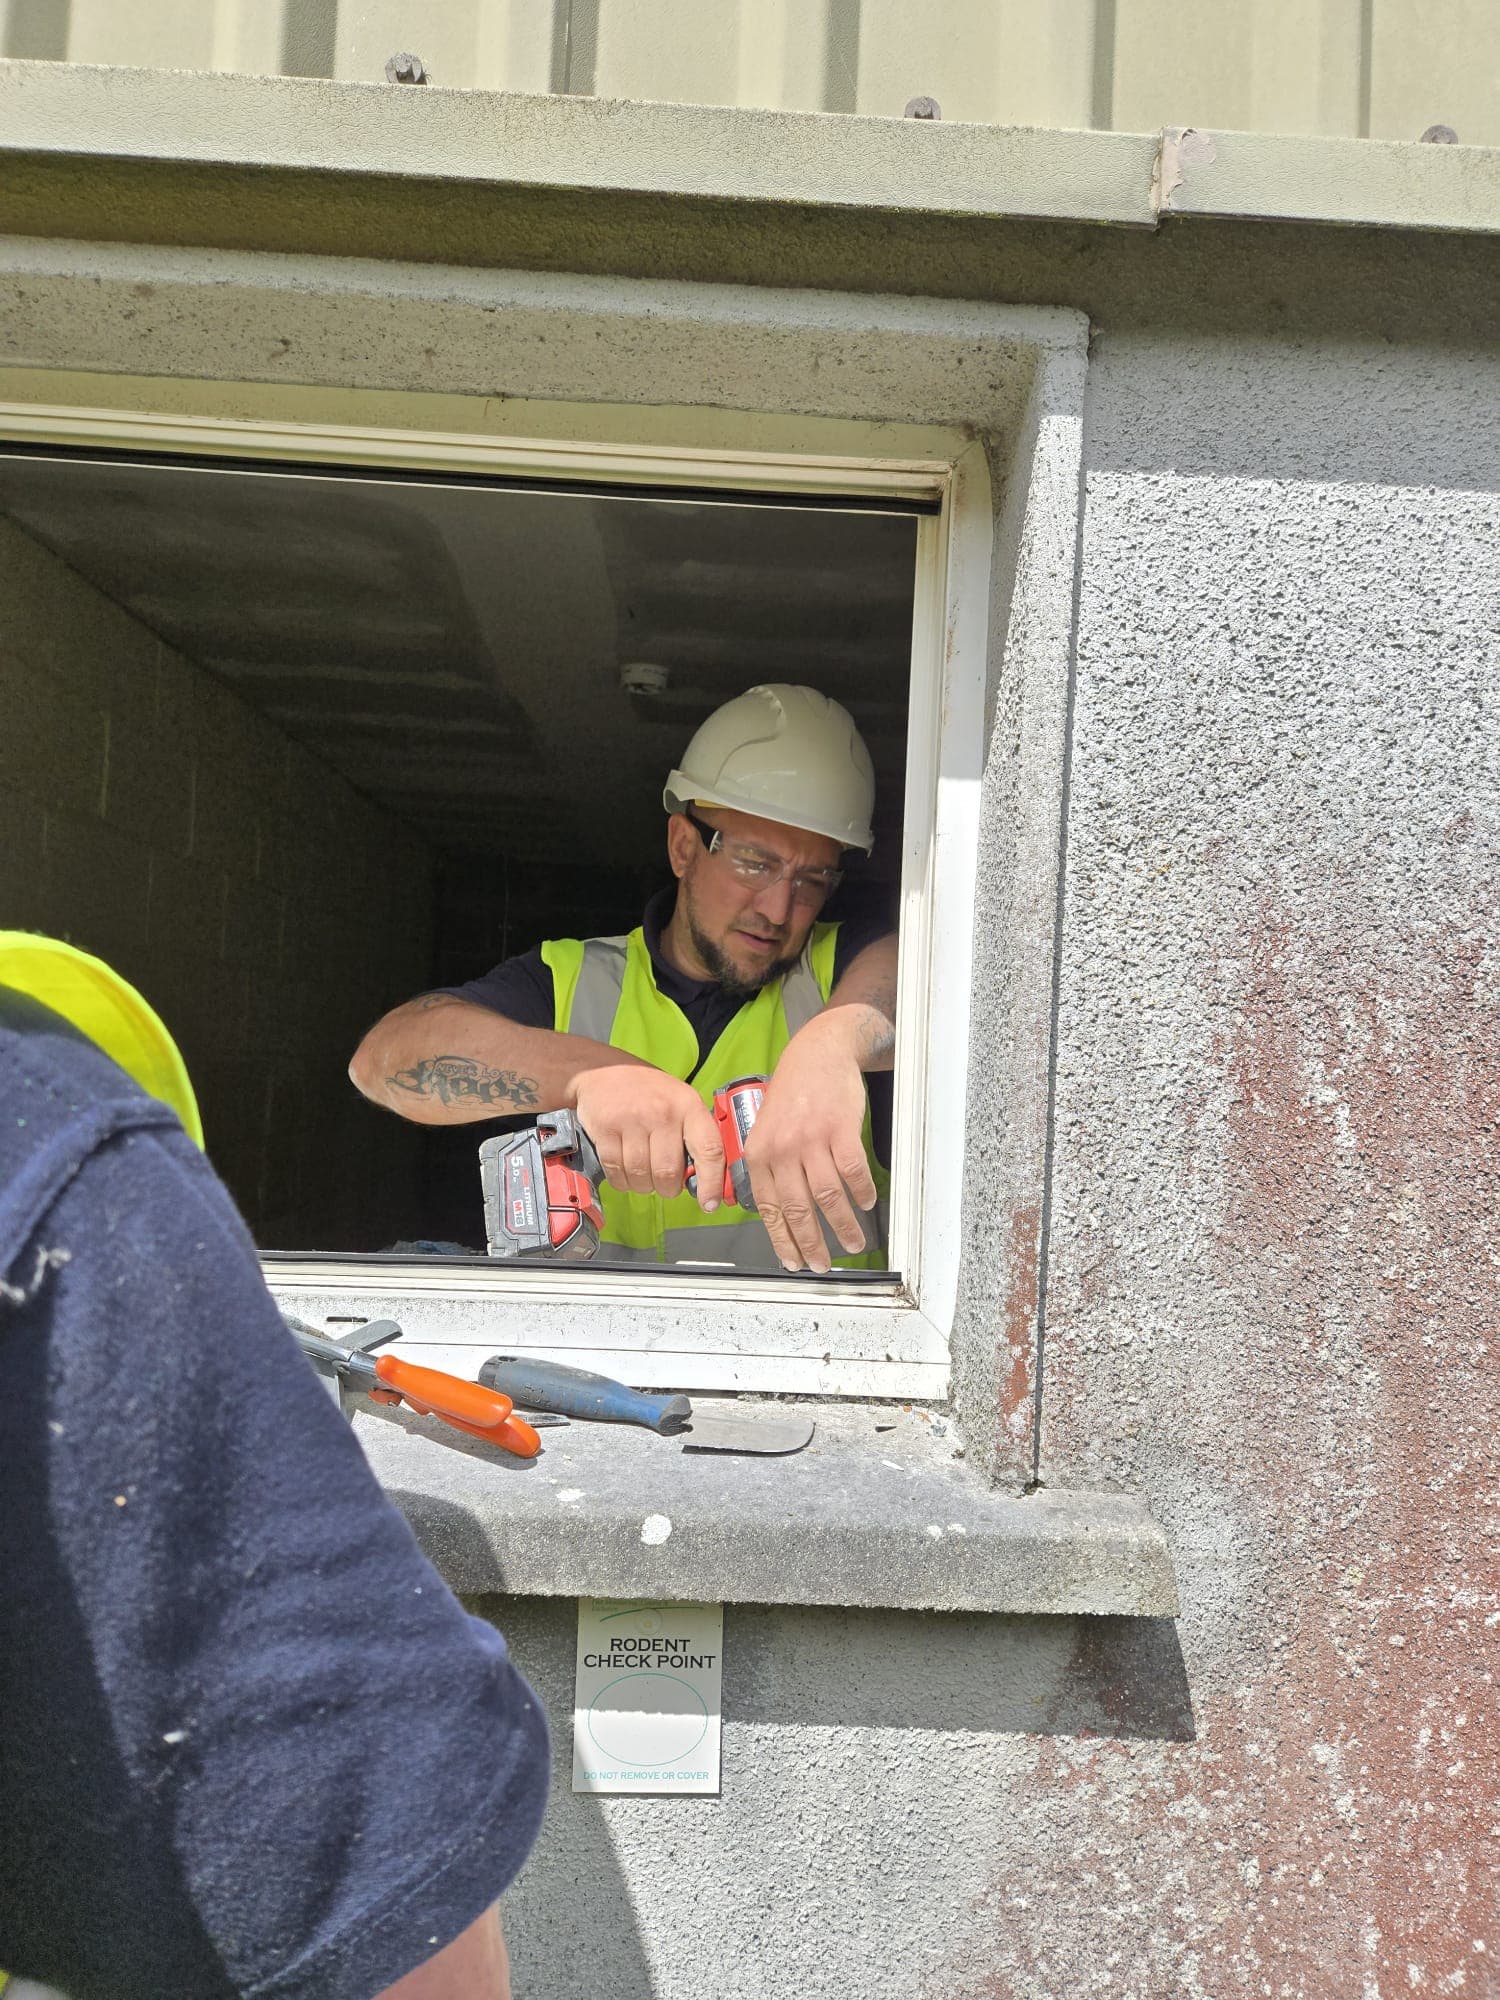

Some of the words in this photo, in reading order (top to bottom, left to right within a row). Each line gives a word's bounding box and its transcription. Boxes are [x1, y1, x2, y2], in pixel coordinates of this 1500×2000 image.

[437, 1062, 478, 1076] NEVER
[481, 1067, 518, 1082] LOSE
[513, 1200, 525, 1226] M18
[610, 1638, 690, 1653] RODENT
[583, 1654, 652, 1668] CHECK
[657, 1655, 716, 1669] POINT
[583, 1771, 598, 1780] DO
[599, 1771, 619, 1780] NOT
[620, 1771, 660, 1780] REMOVE
[661, 1771, 675, 1780] OR
[677, 1771, 709, 1780] COVER
